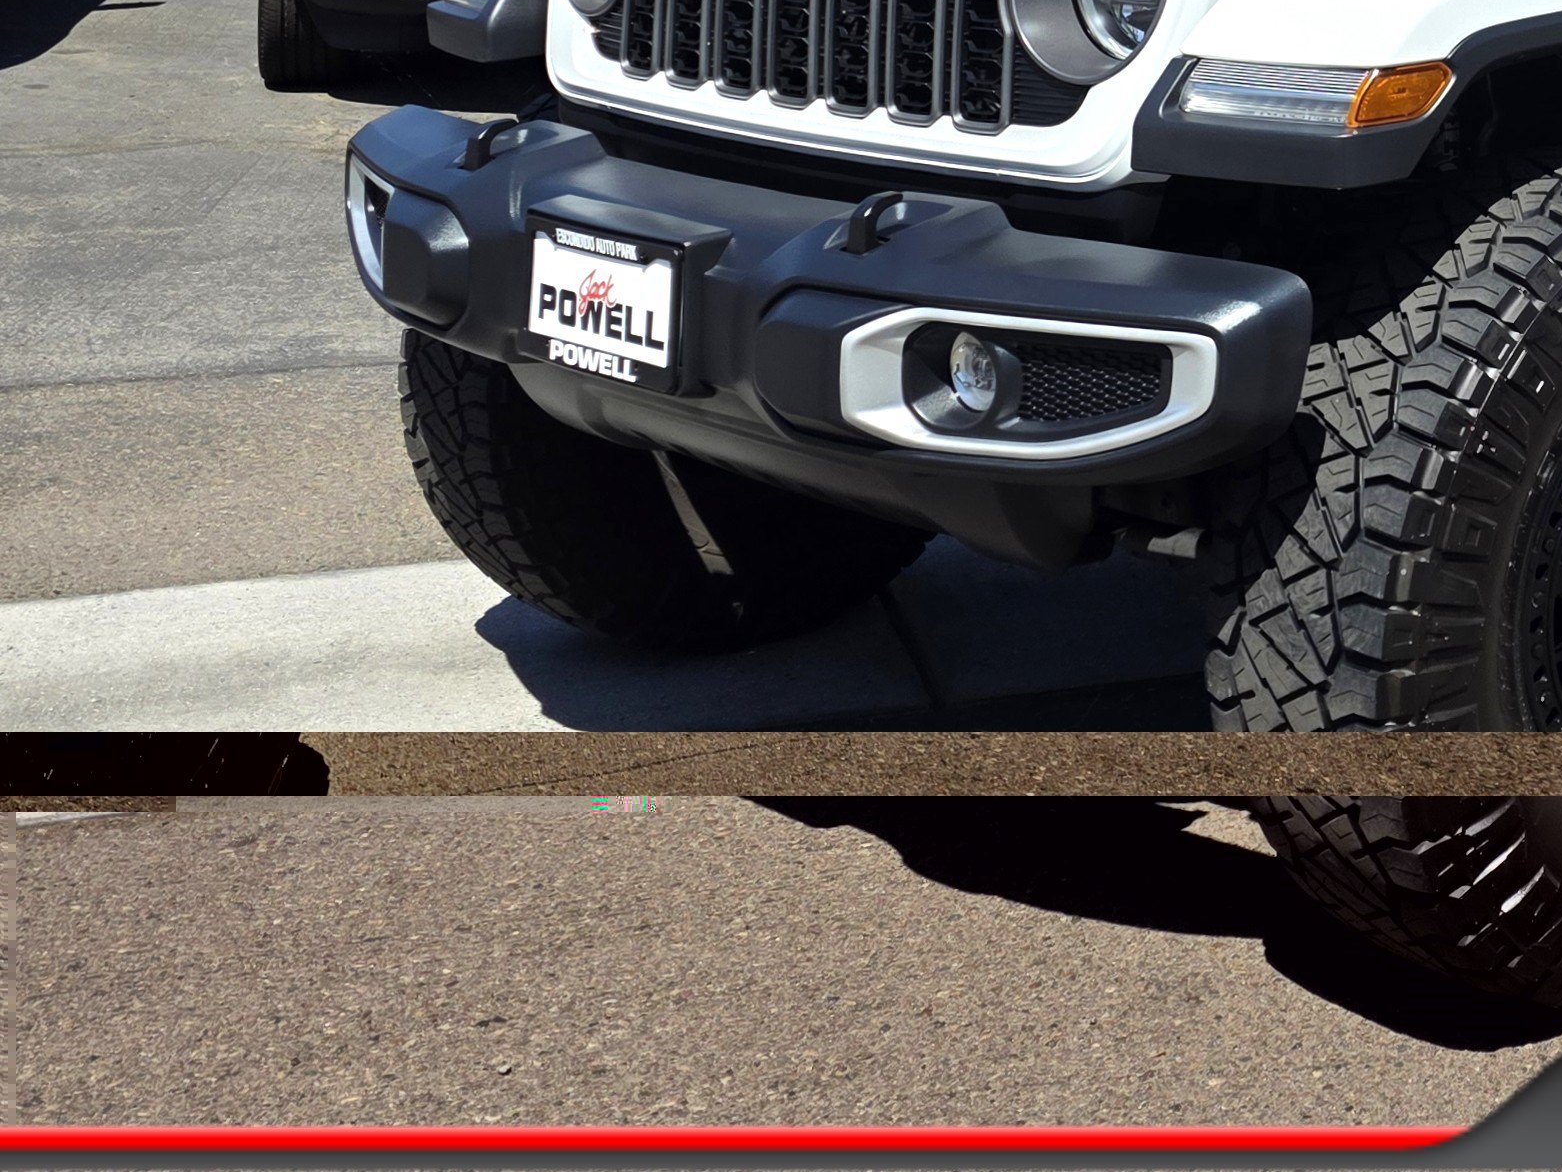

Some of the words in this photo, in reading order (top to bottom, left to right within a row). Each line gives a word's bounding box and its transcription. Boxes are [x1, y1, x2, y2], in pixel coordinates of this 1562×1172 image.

[595, 237, 616, 257] AUTO
[615, 241, 638, 261] PARK
[578, 269, 618, 315] Jack
[538, 282, 665, 351] POWELL
[548, 339, 638, 383] POWELL
